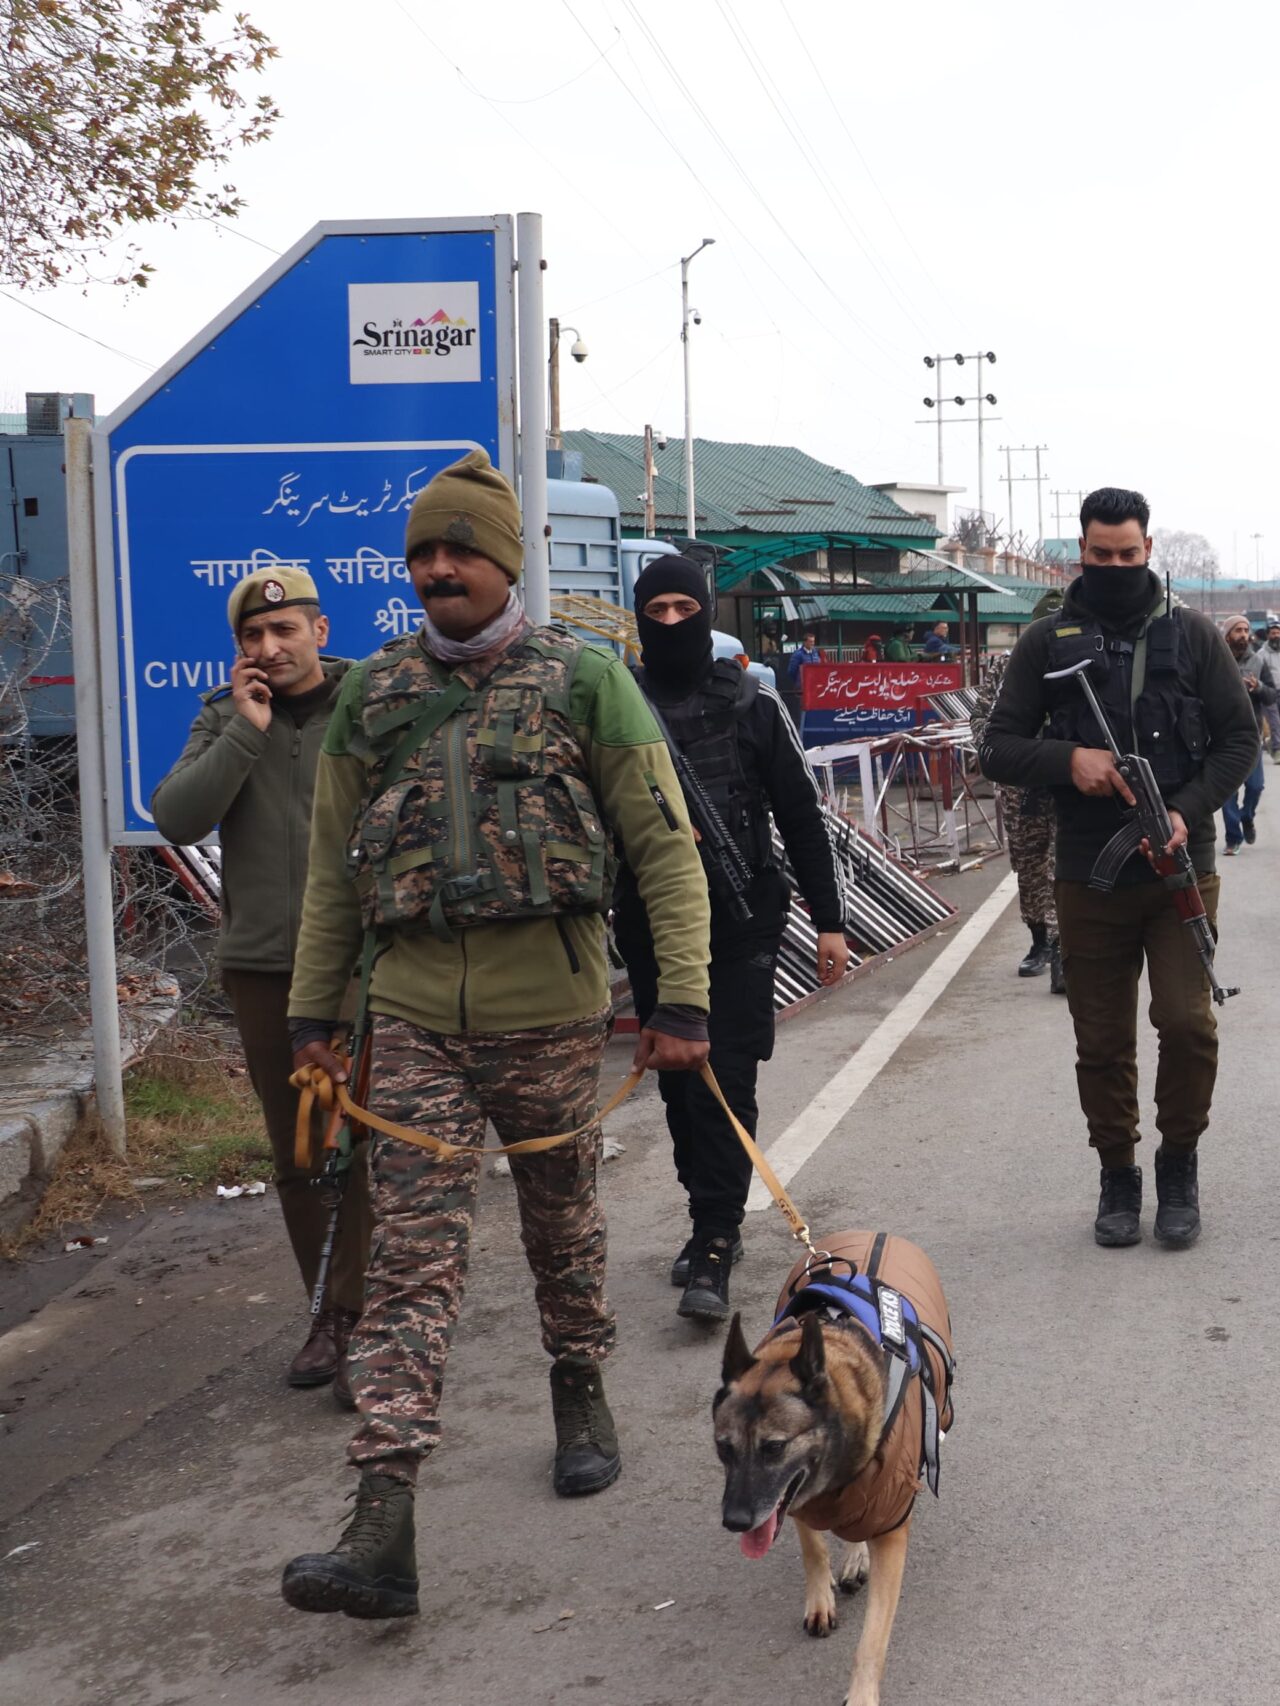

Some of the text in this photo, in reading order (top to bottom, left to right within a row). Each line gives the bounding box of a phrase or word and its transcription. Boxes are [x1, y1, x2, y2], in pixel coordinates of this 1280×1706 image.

[353, 319, 476, 356] Srinagar
[394, 348, 412, 356] CITY
[144, 661, 233, 689] CIVIL
[881, 1291, 902, 1340] POLICE K9
